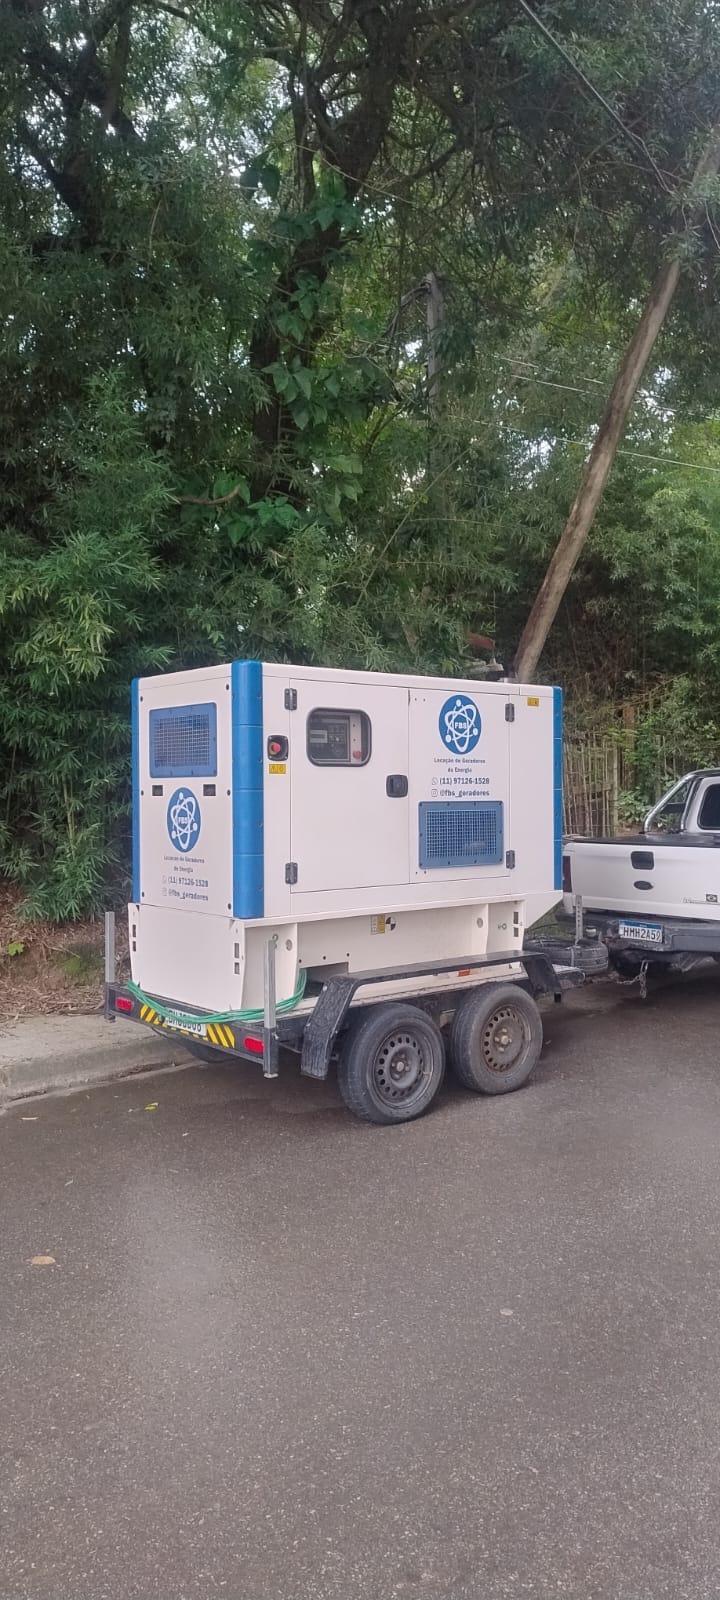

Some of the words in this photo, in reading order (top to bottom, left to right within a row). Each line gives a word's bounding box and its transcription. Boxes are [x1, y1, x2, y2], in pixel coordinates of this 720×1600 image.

[454, 722, 467, 730] FBS
[439, 777, 452, 785] (11)
[453, 777, 490, 785] 97126-1528
[440, 790, 490, 798] @fbs_geradores
[179, 877, 208, 888] 97126-1528
